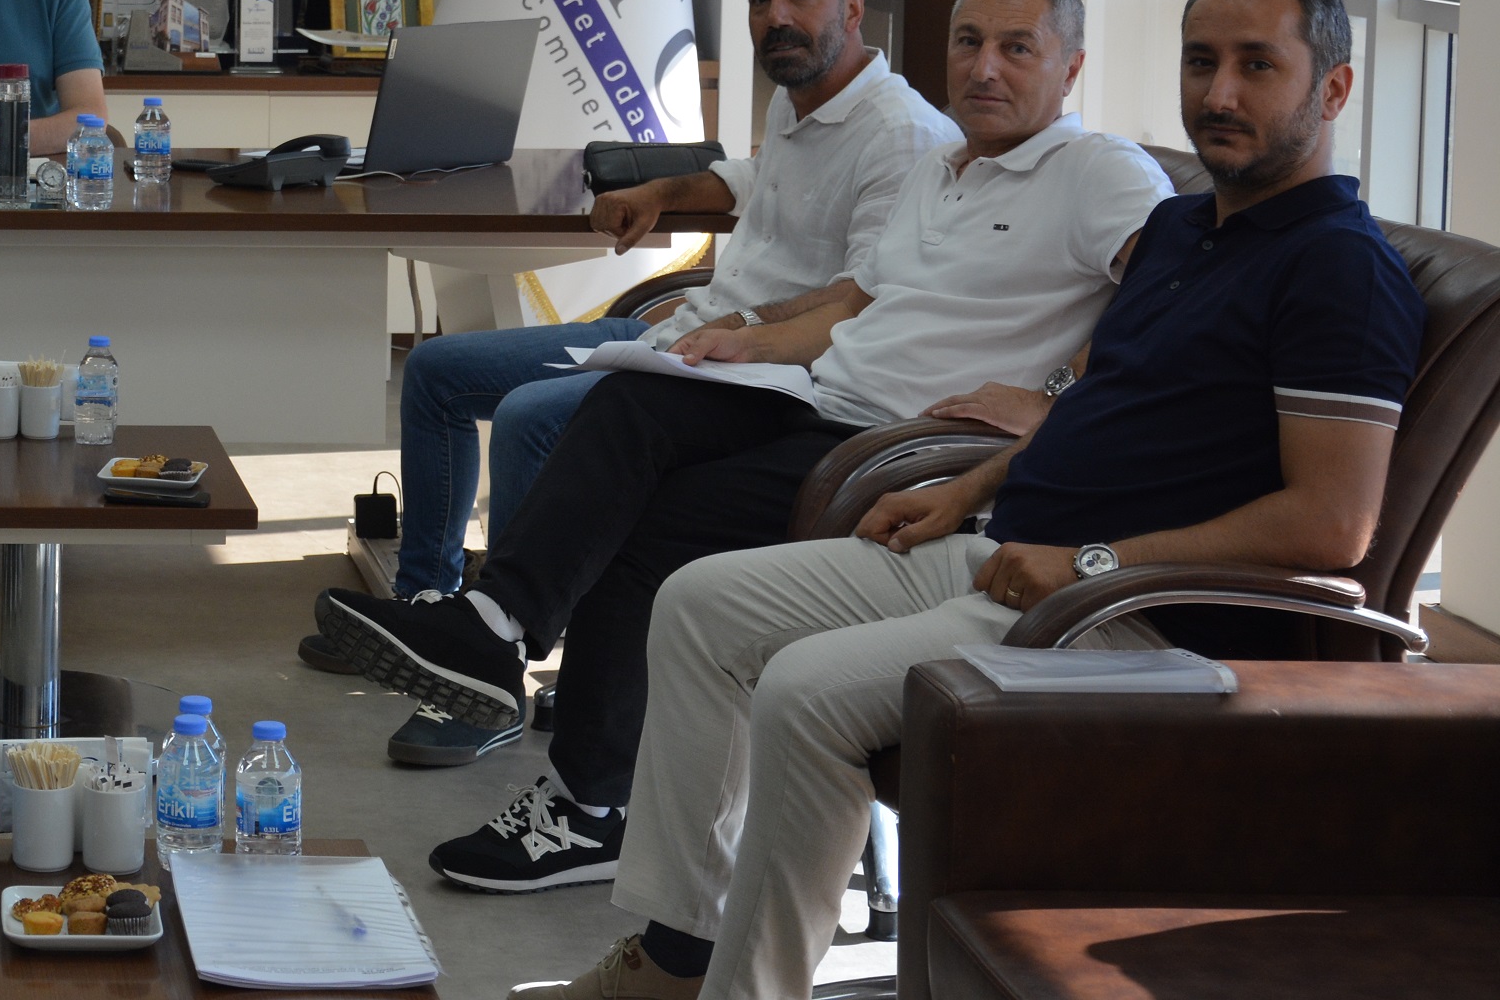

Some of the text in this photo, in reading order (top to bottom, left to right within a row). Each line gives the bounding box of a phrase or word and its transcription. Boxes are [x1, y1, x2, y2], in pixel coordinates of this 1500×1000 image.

[603, 59, 655, 143] Odas
[138, 139, 162, 149] Erikli
[157, 796, 195, 818] Erikli
